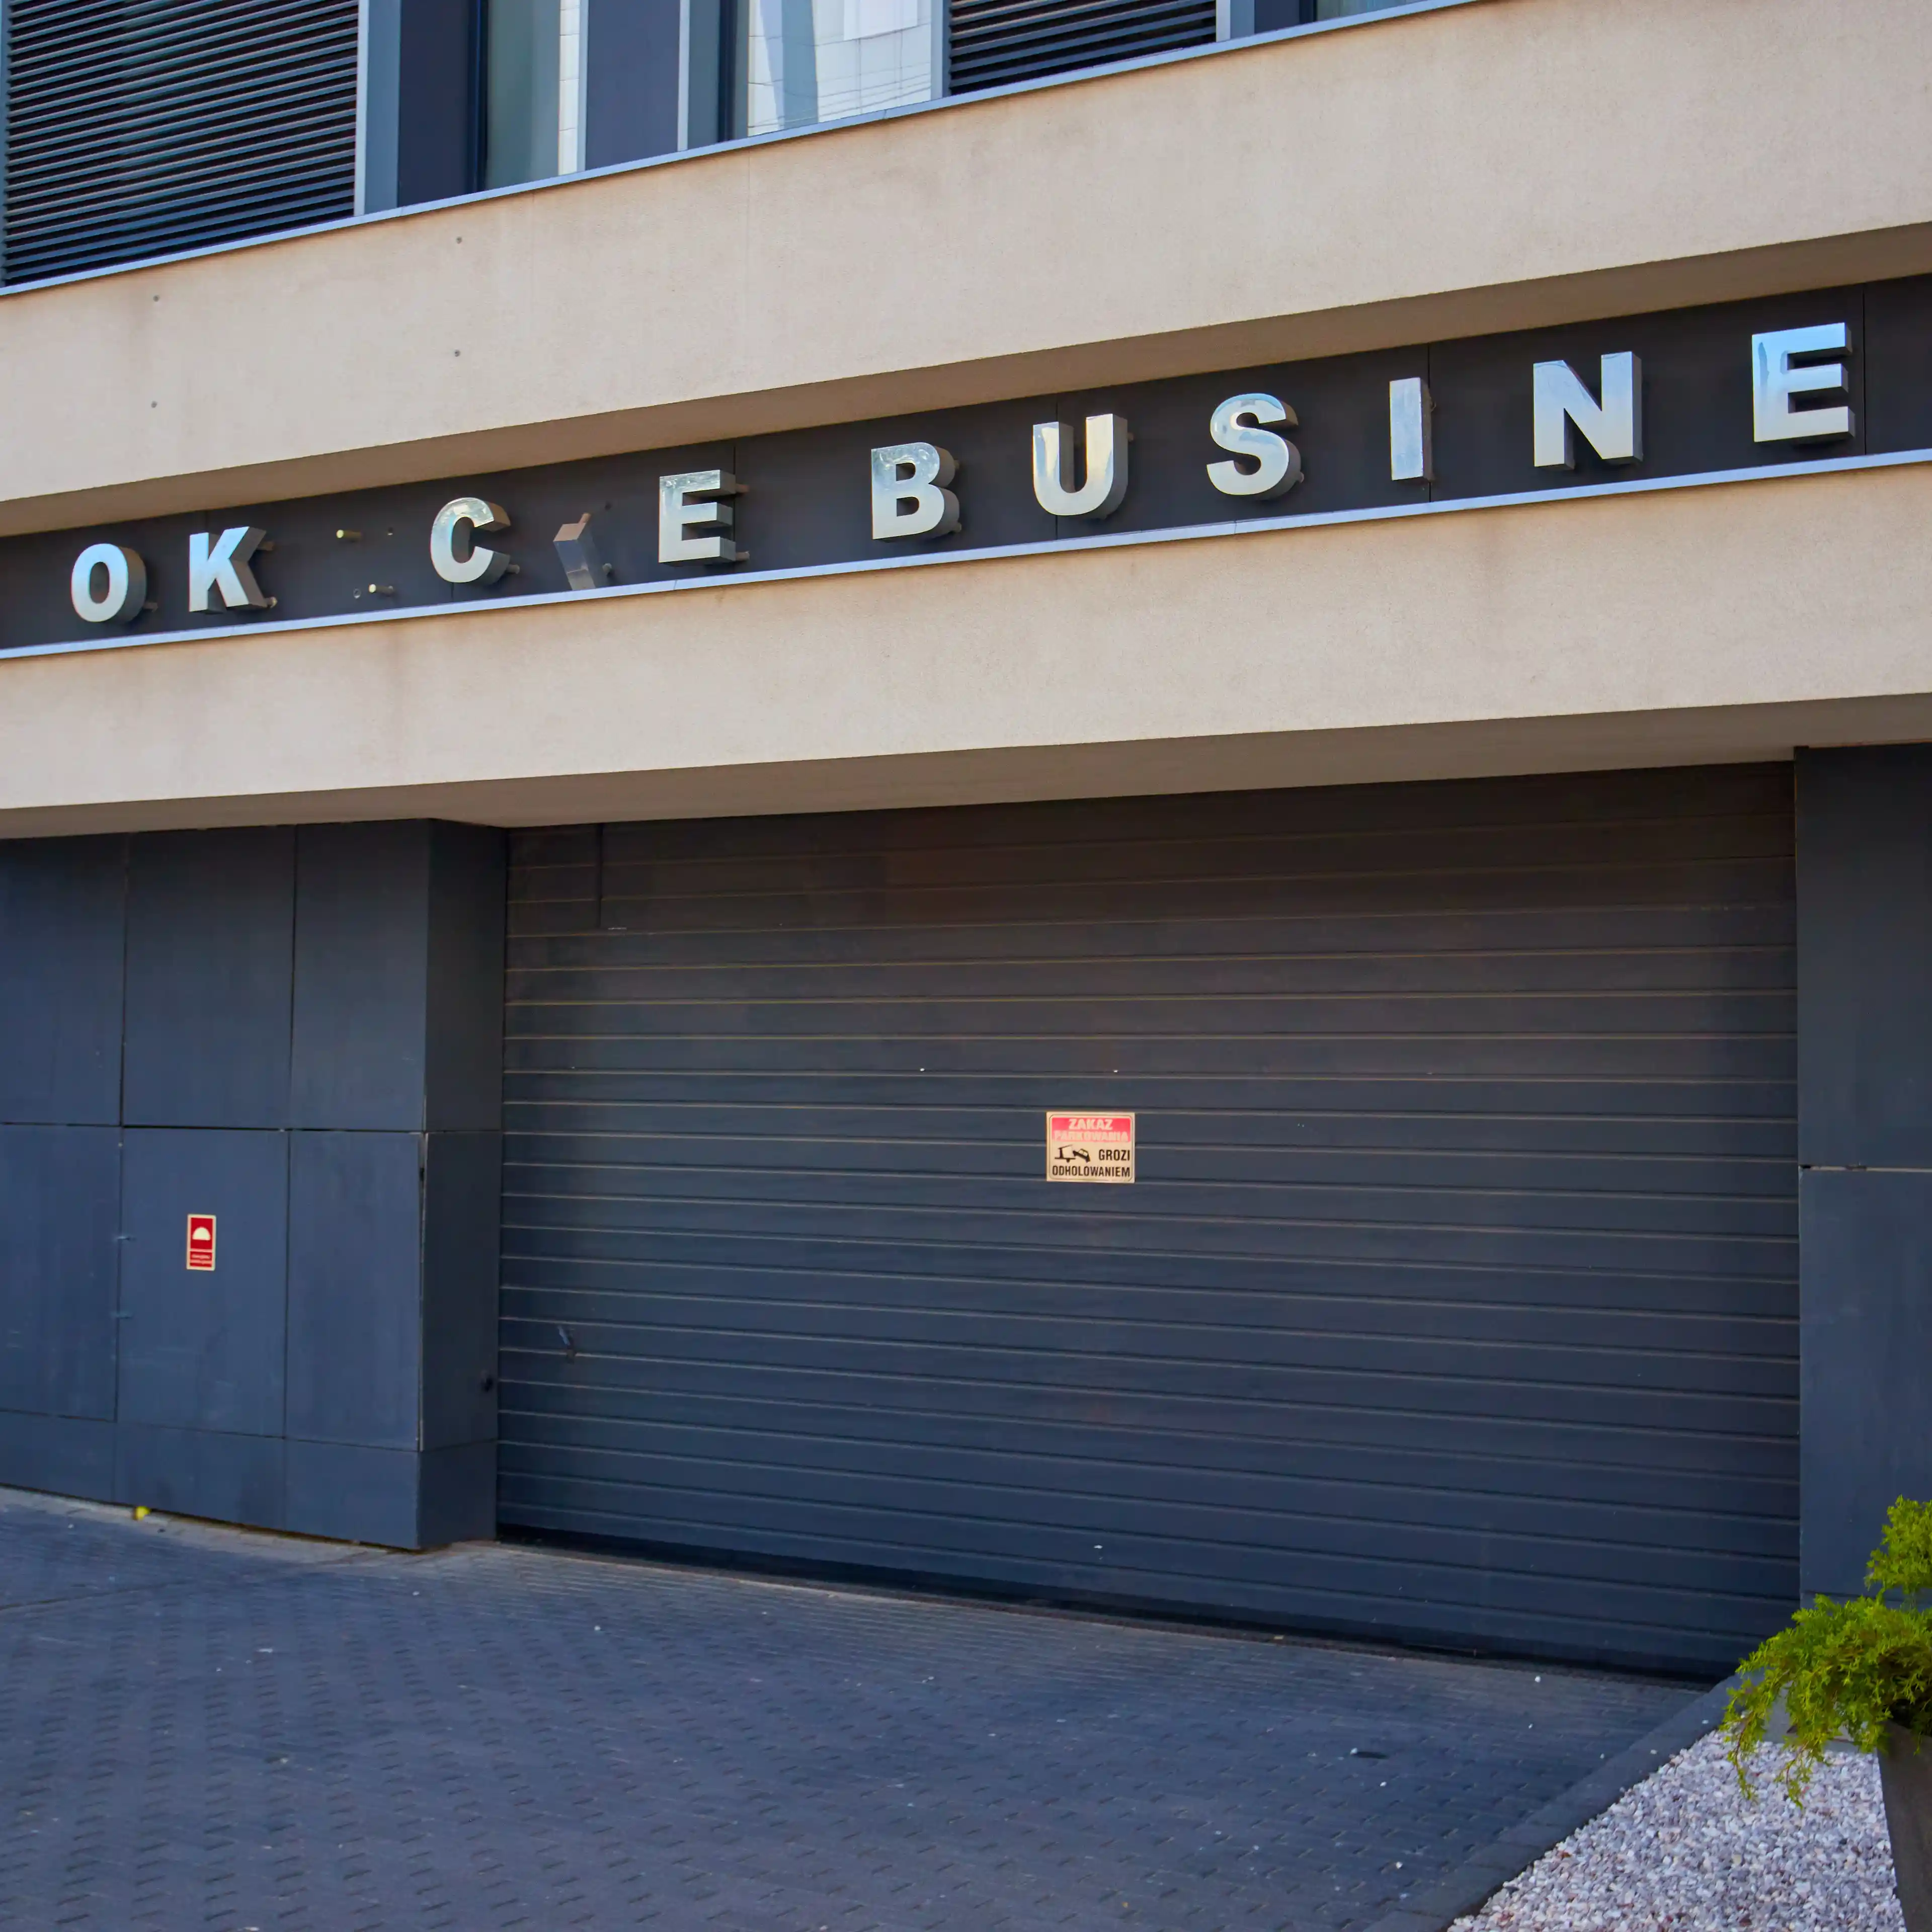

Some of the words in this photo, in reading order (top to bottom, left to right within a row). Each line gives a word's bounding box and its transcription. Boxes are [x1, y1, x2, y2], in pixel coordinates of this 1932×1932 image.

[871, 322, 1856, 540] BUSINE
[1069, 1118, 1113, 1131] ZAKAZ
[1054, 1131, 1129, 1142] PARKOWANIA
[1098, 1149, 1131, 1161] GROZI
[1052, 1165, 1131, 1177] ODHOLOWANIEM
